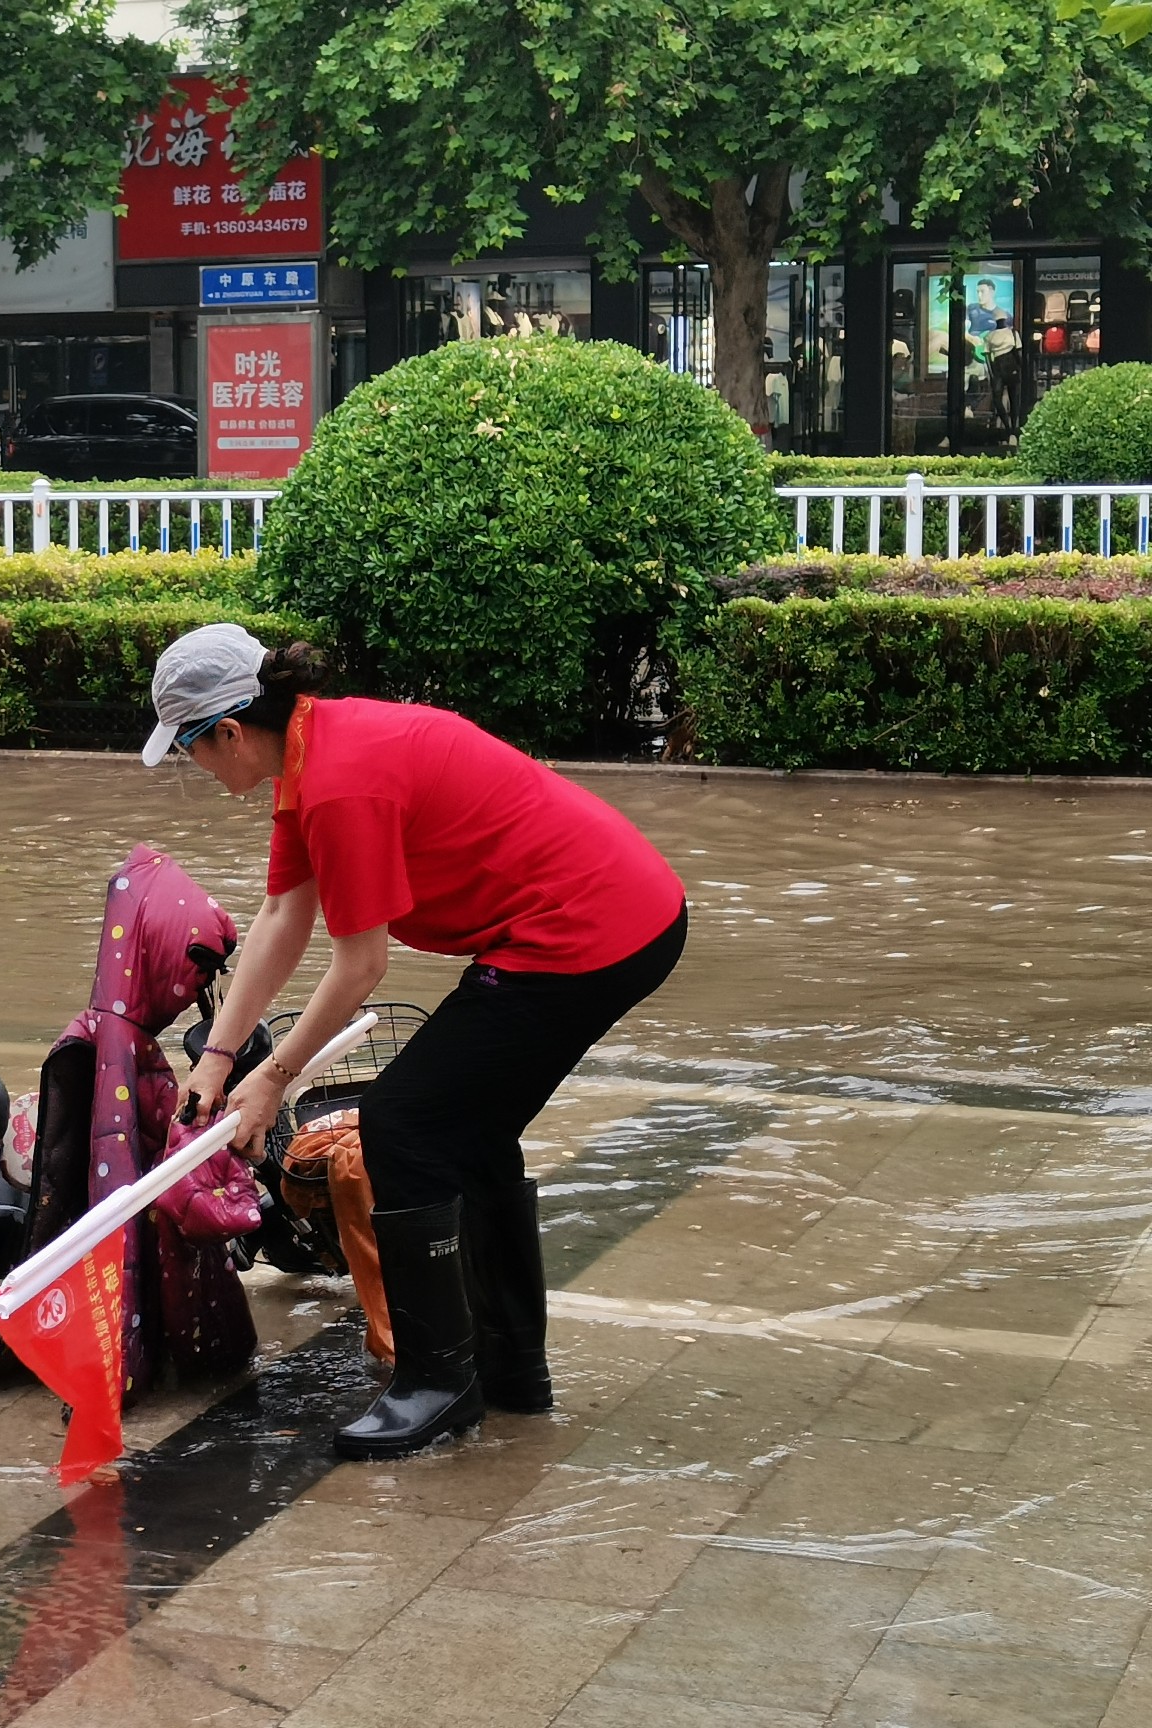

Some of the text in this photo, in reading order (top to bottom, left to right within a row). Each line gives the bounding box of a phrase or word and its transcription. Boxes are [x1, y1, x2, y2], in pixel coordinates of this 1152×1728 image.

[173, 185, 211, 205] 鲜花
[213, 217, 308, 234] 13603434679
[219, 271, 299, 288] 中原东路
[235, 350, 281, 378] 时光
[212, 380, 304, 409] 医疗美容
